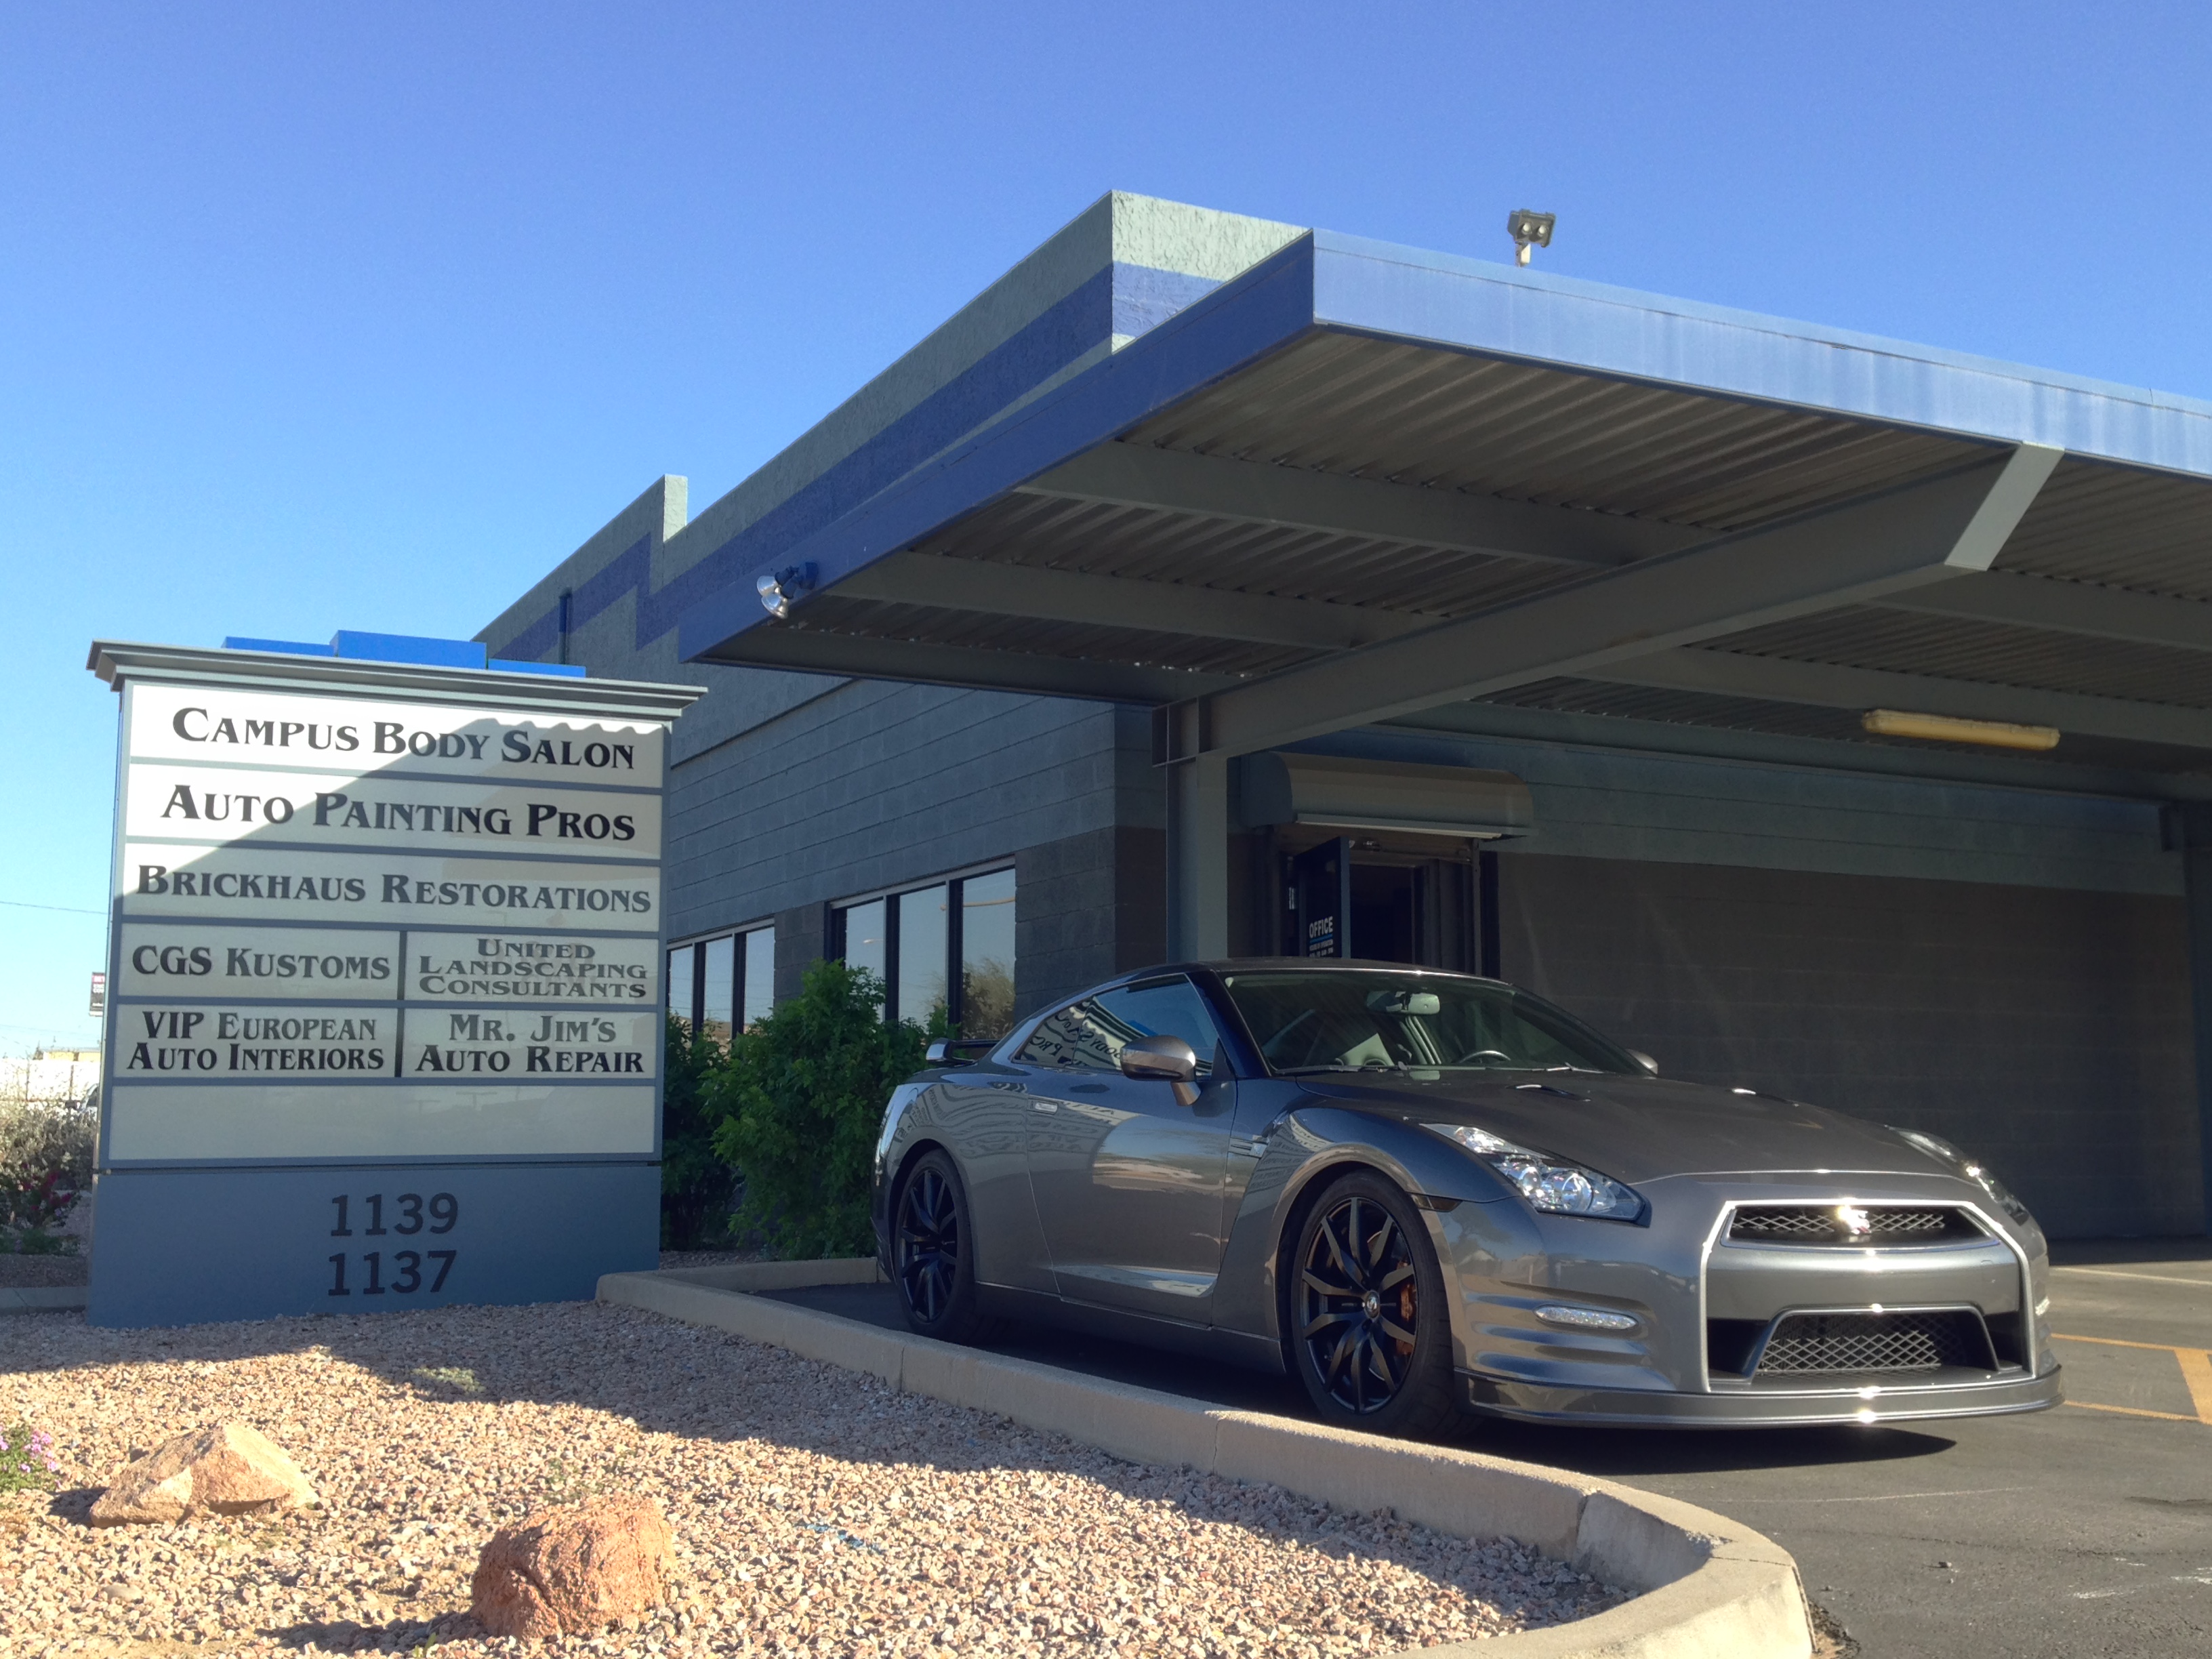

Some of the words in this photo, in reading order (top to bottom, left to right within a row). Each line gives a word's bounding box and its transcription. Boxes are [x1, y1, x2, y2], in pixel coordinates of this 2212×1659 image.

[172, 707, 360, 752] CAMPUS
[373, 721, 490, 760] BODY
[501, 729, 634, 769] SALON
[160, 784, 294, 824] AUTO
[312, 792, 512, 835] PAINTING
[526, 803, 636, 841] PROS
[136, 864, 366, 902] BRICKHAUS
[380, 874, 651, 913] RESTORATIONS
[1309, 916, 1333, 939] OFFICE
[132, 945, 212, 976] CGS
[225, 947, 390, 980] KUSTOMS
[477, 938, 596, 958] UNITED
[419, 956, 648, 979] LANDSCAPING
[419, 976, 647, 998] CONSULTANTS
[142, 1010, 205, 1039] VIP
[217, 1012, 377, 1040] EUROPEAN
[449, 1014, 515, 1042] MR.
[530, 1015, 617, 1042] JIM'S
[126, 1042, 218, 1069] AUTO
[228, 1043, 384, 1070] INTERIORS
[415, 1044, 510, 1071] AUTO
[525, 1046, 645, 1073] REPAIR
[331, 1192, 459, 1236] 1139
[327, 1250, 457, 1296] 1137
